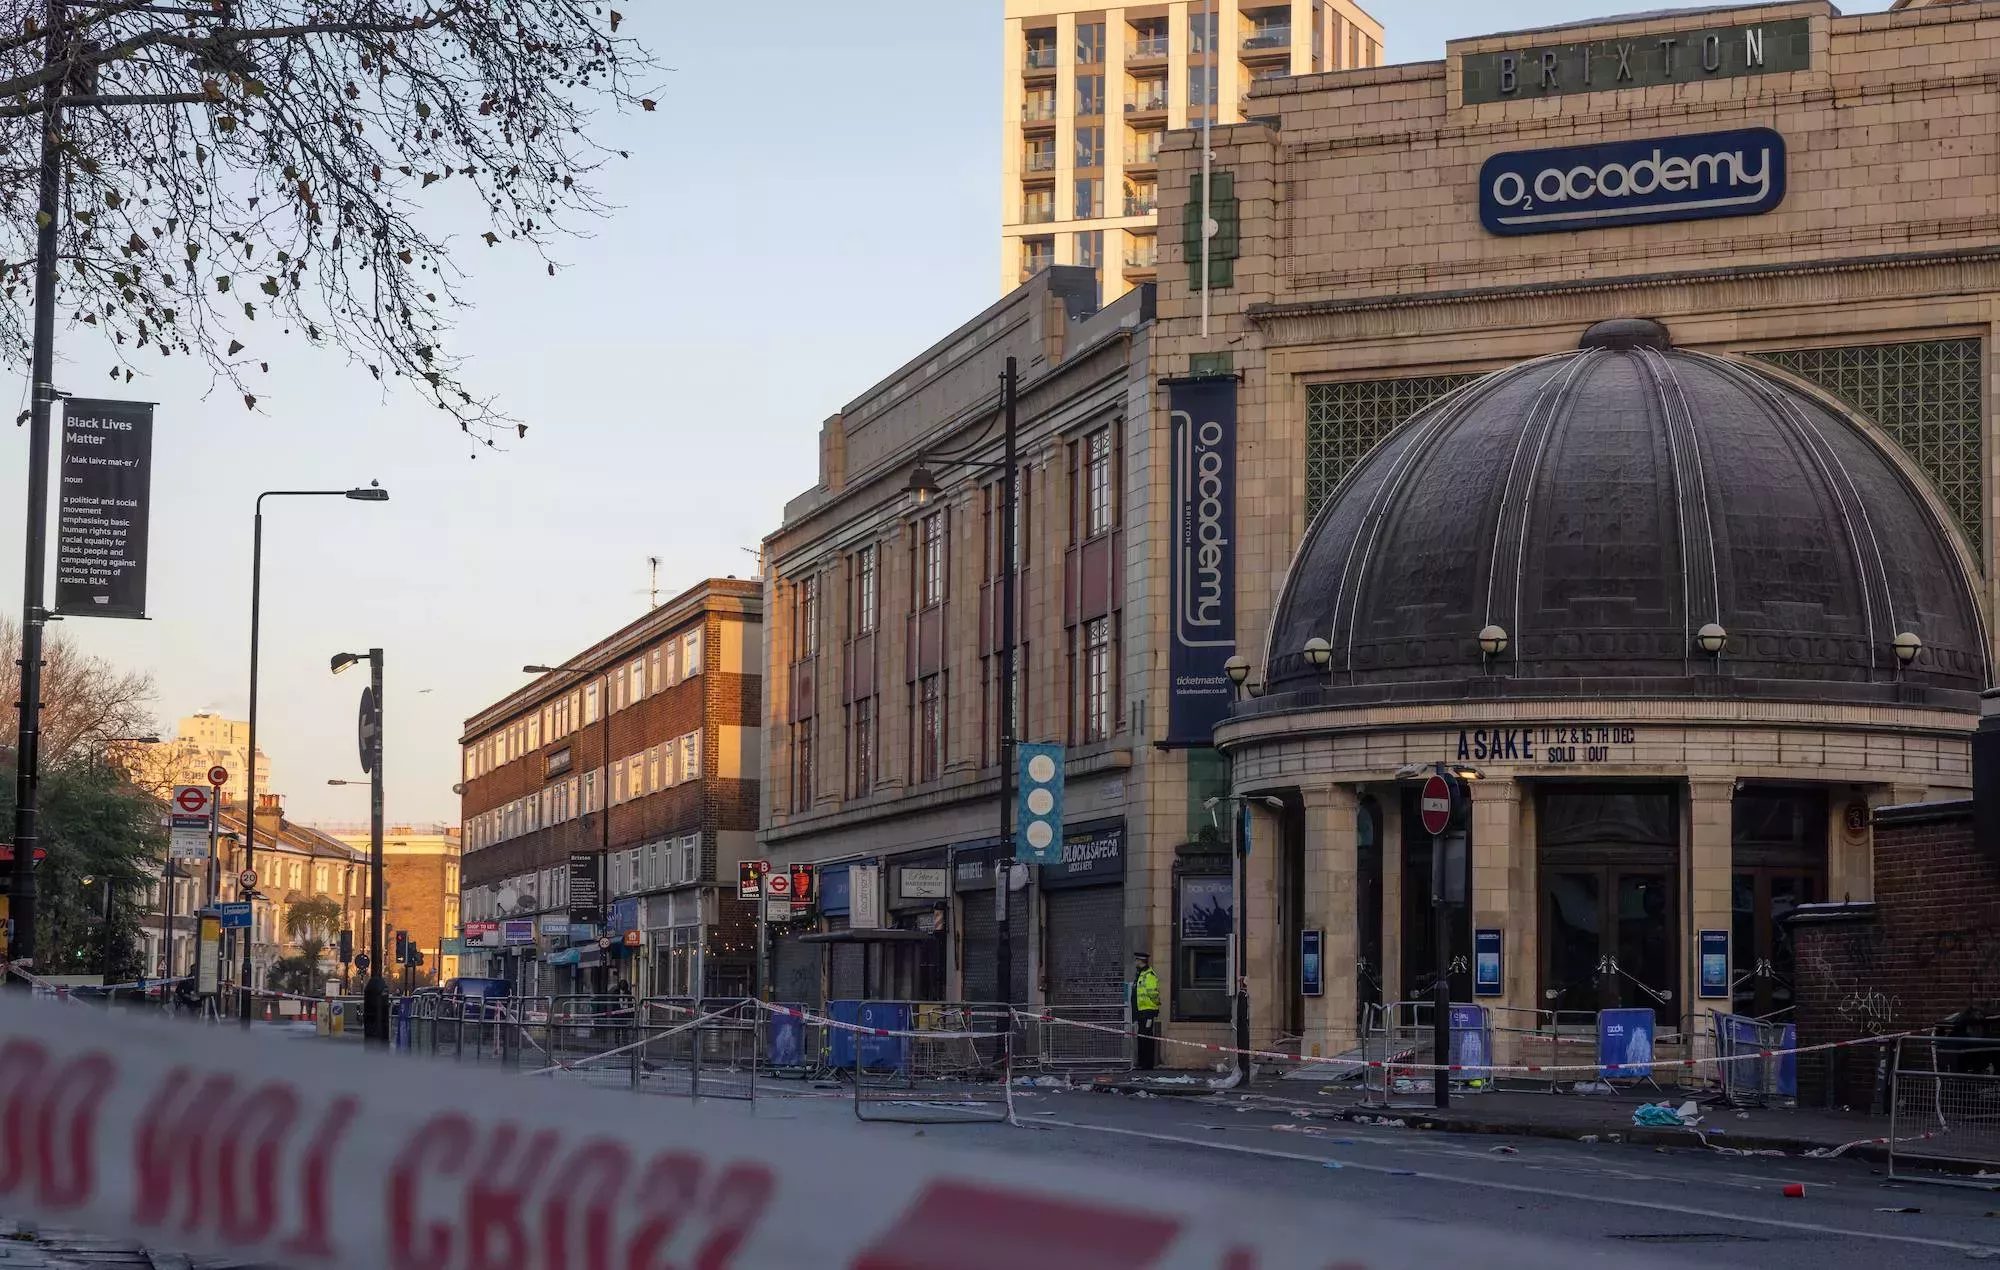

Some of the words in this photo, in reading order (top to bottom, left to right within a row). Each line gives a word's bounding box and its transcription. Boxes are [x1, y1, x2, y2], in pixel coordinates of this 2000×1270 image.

[1501, 28, 1764, 93] BRIXTON
[67, 416, 99, 429] Black
[102, 418, 133, 431] Lives
[66, 432, 106, 445] Matter
[71, 456, 88, 464] blak
[89, 457, 107, 465] laivz
[107, 459, 133, 467] mat-er
[69, 496, 99, 504] political
[63, 506, 102, 514] movement
[62, 516, 109, 526] emphasising
[110, 518, 130, 526] basic
[89, 527, 112, 536] rights
[84, 537, 114, 547] equality
[115, 538, 127, 546] for
[1198, 452, 1229, 626] academy
[61, 545, 82, 554] Black
[83, 547, 108, 555] people
[61, 557, 108, 566] campaigning
[109, 559, 136, 567] against
[60, 566, 88, 574] various
[90, 567, 112, 575] forms
[60, 576, 88, 584] racism.
[89, 577, 108, 585] BLM.
[1176, 676, 1228, 685] ticketmaster
[1457, 729, 1534, 761] ASAKE
[1557, 728, 1566, 743] 12
[1571, 728, 1579, 744] &
[1613, 728, 1635, 744] DEC
[1548, 747, 1576, 763] SOLD
[1588, 746, 1609, 762] OUT
[761, 862, 768, 872] B
[958, 861, 983, 880] PROVIDENCE
[243, 874, 255, 883] 20
